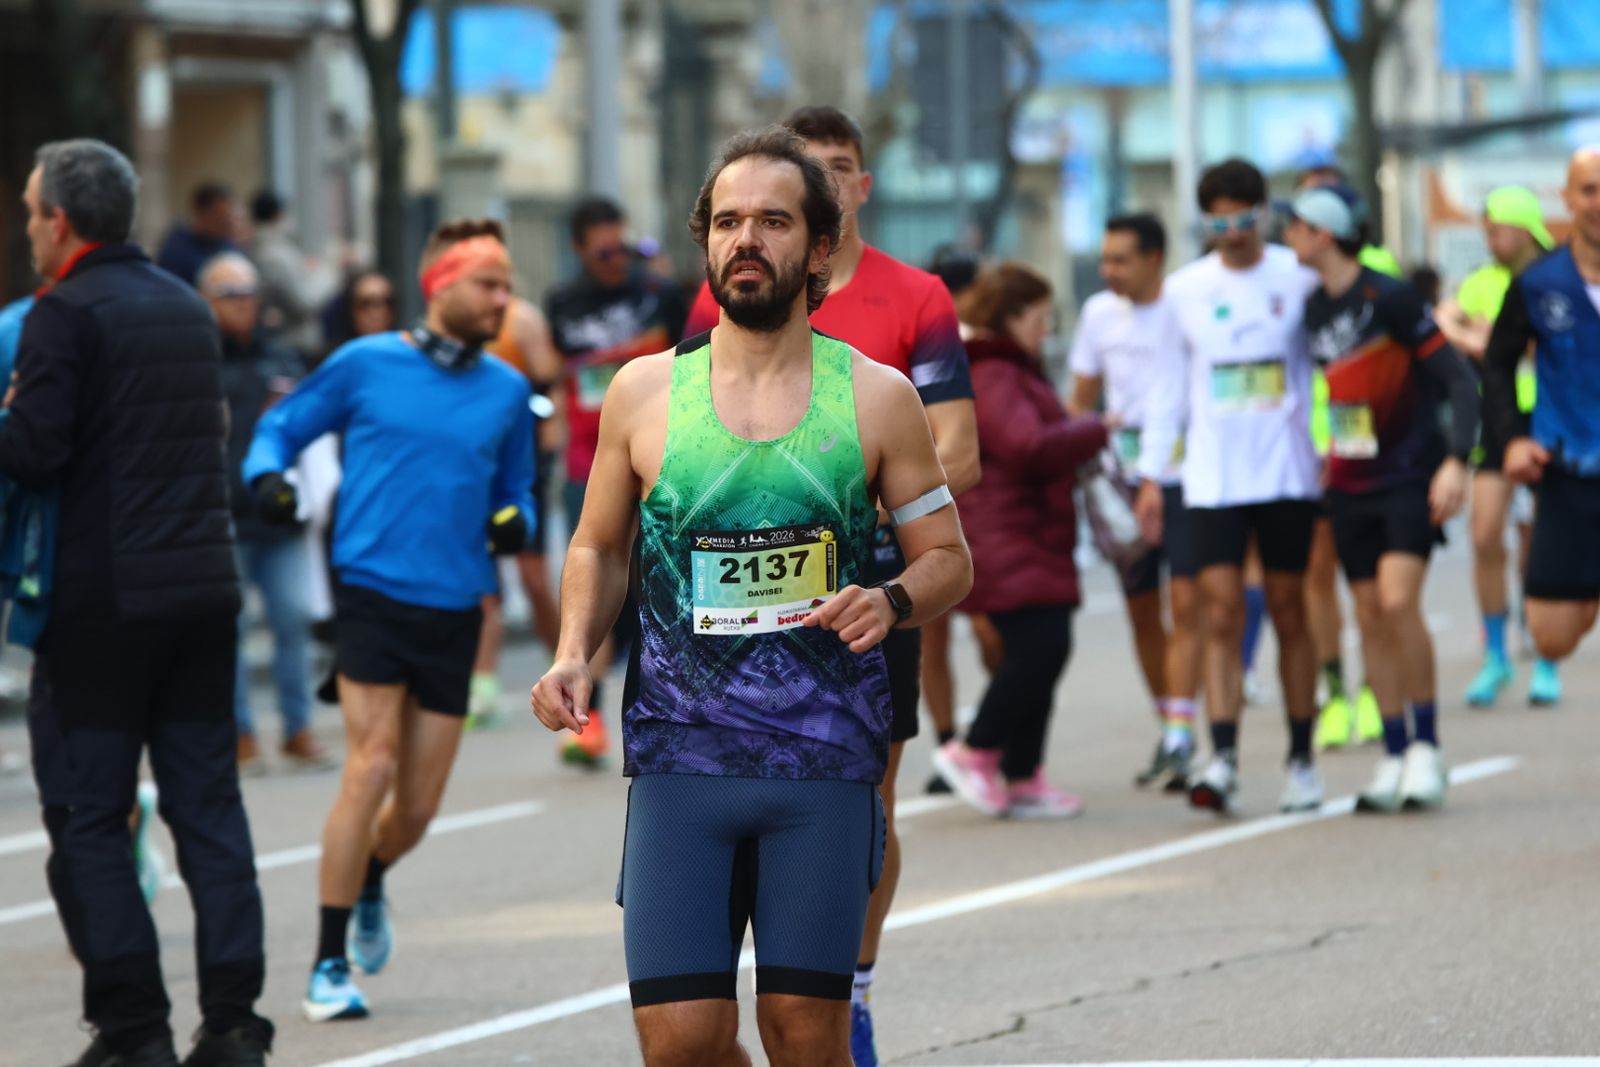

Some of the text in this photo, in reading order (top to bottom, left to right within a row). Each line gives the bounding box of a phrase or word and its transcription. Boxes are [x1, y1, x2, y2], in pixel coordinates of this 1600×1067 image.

[769, 530, 795, 543] 2026
[719, 550, 810, 584] 2137
[747, 587, 783, 598] DAVISEI
